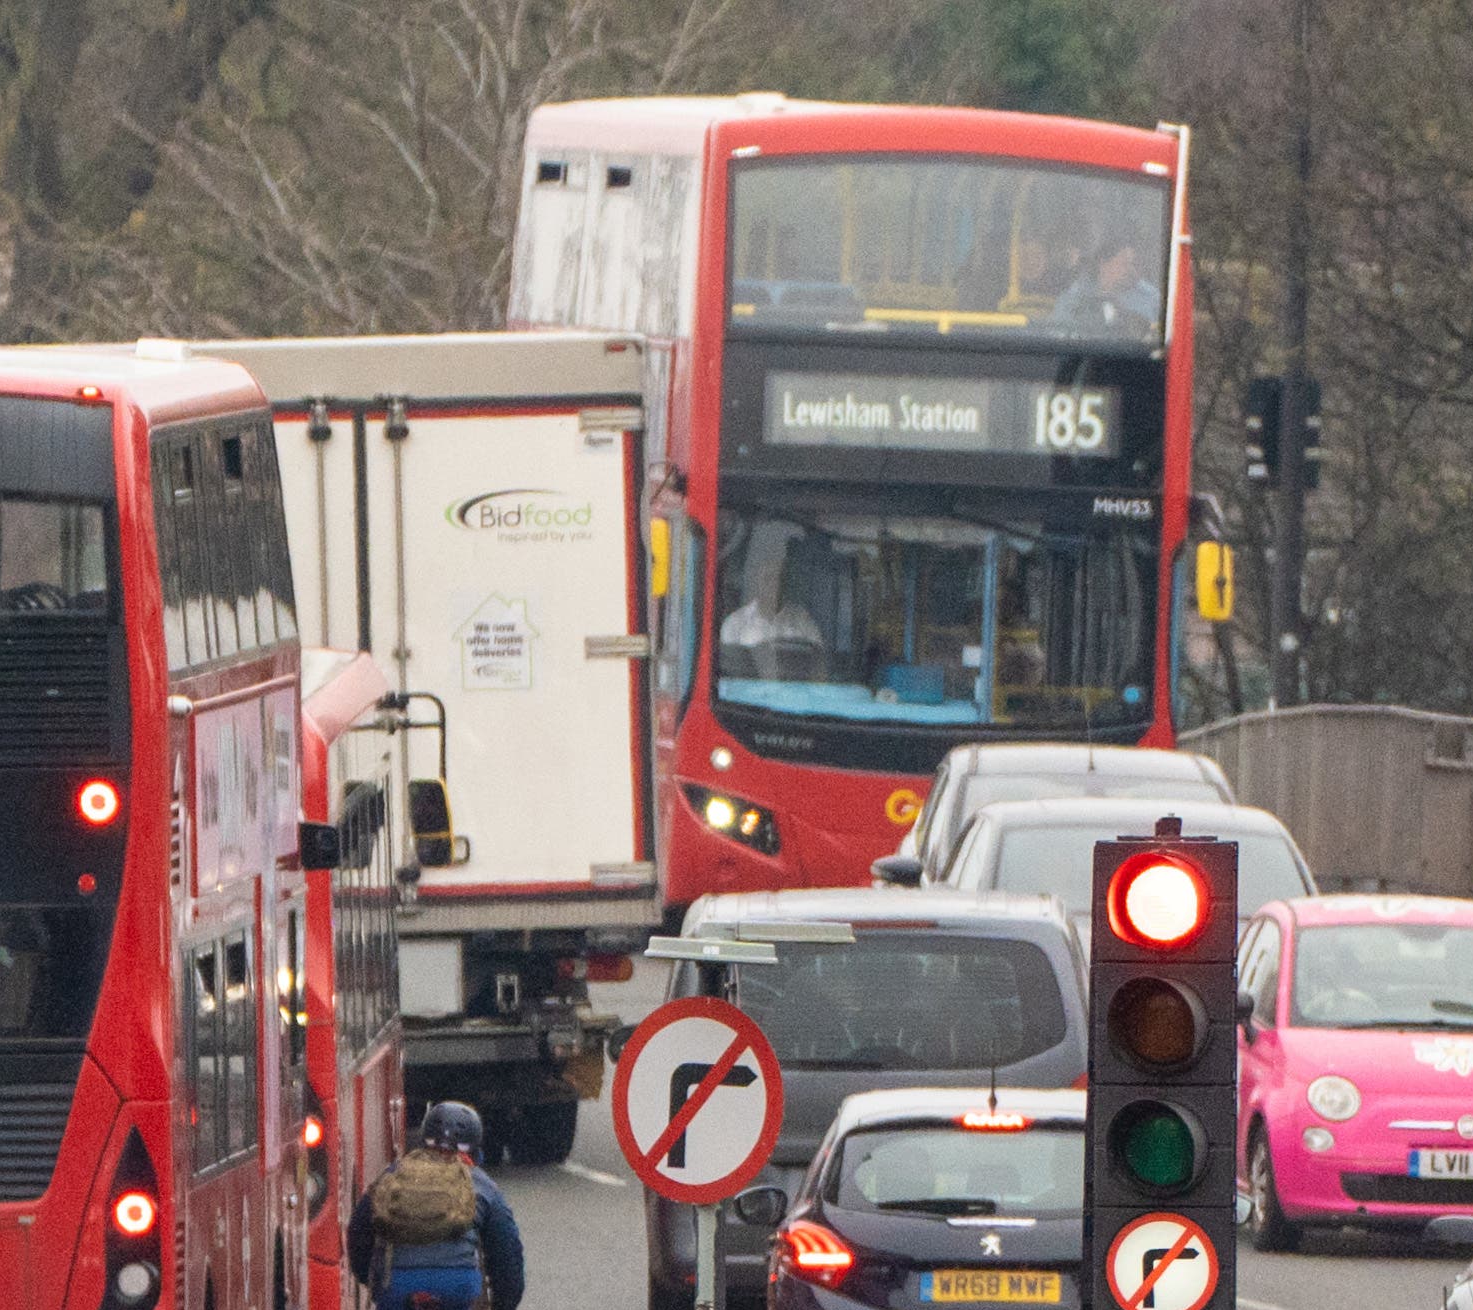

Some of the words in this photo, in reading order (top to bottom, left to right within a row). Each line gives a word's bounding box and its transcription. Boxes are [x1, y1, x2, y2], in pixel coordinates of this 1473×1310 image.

[783, 392, 890, 429] Lewisham
[899, 395, 979, 433] Station
[1035, 394, 1105, 449] 185
[480, 503, 592, 529] Bidfood
